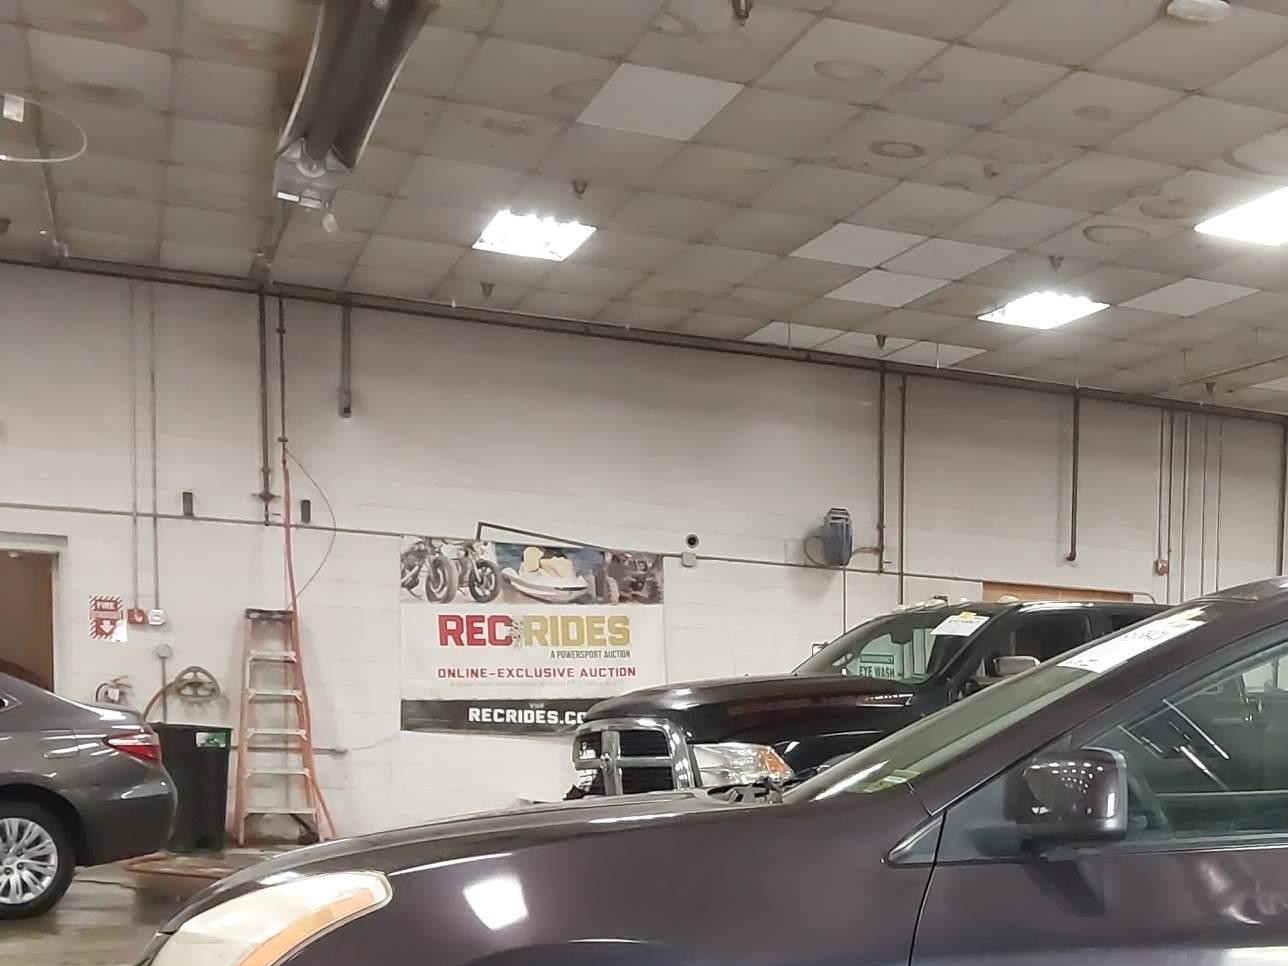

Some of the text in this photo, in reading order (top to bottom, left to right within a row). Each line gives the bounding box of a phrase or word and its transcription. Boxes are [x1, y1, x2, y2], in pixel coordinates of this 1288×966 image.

[96, 601, 115, 610] FIRE
[438, 615, 632, 646] REC RIDES
[550, 650, 631, 659] A POWERSPORT AUCTION
[438, 667, 637, 678] ONLINE-EXCLUSIVE AUCTION
[859, 665, 895, 679] EYE WASH
